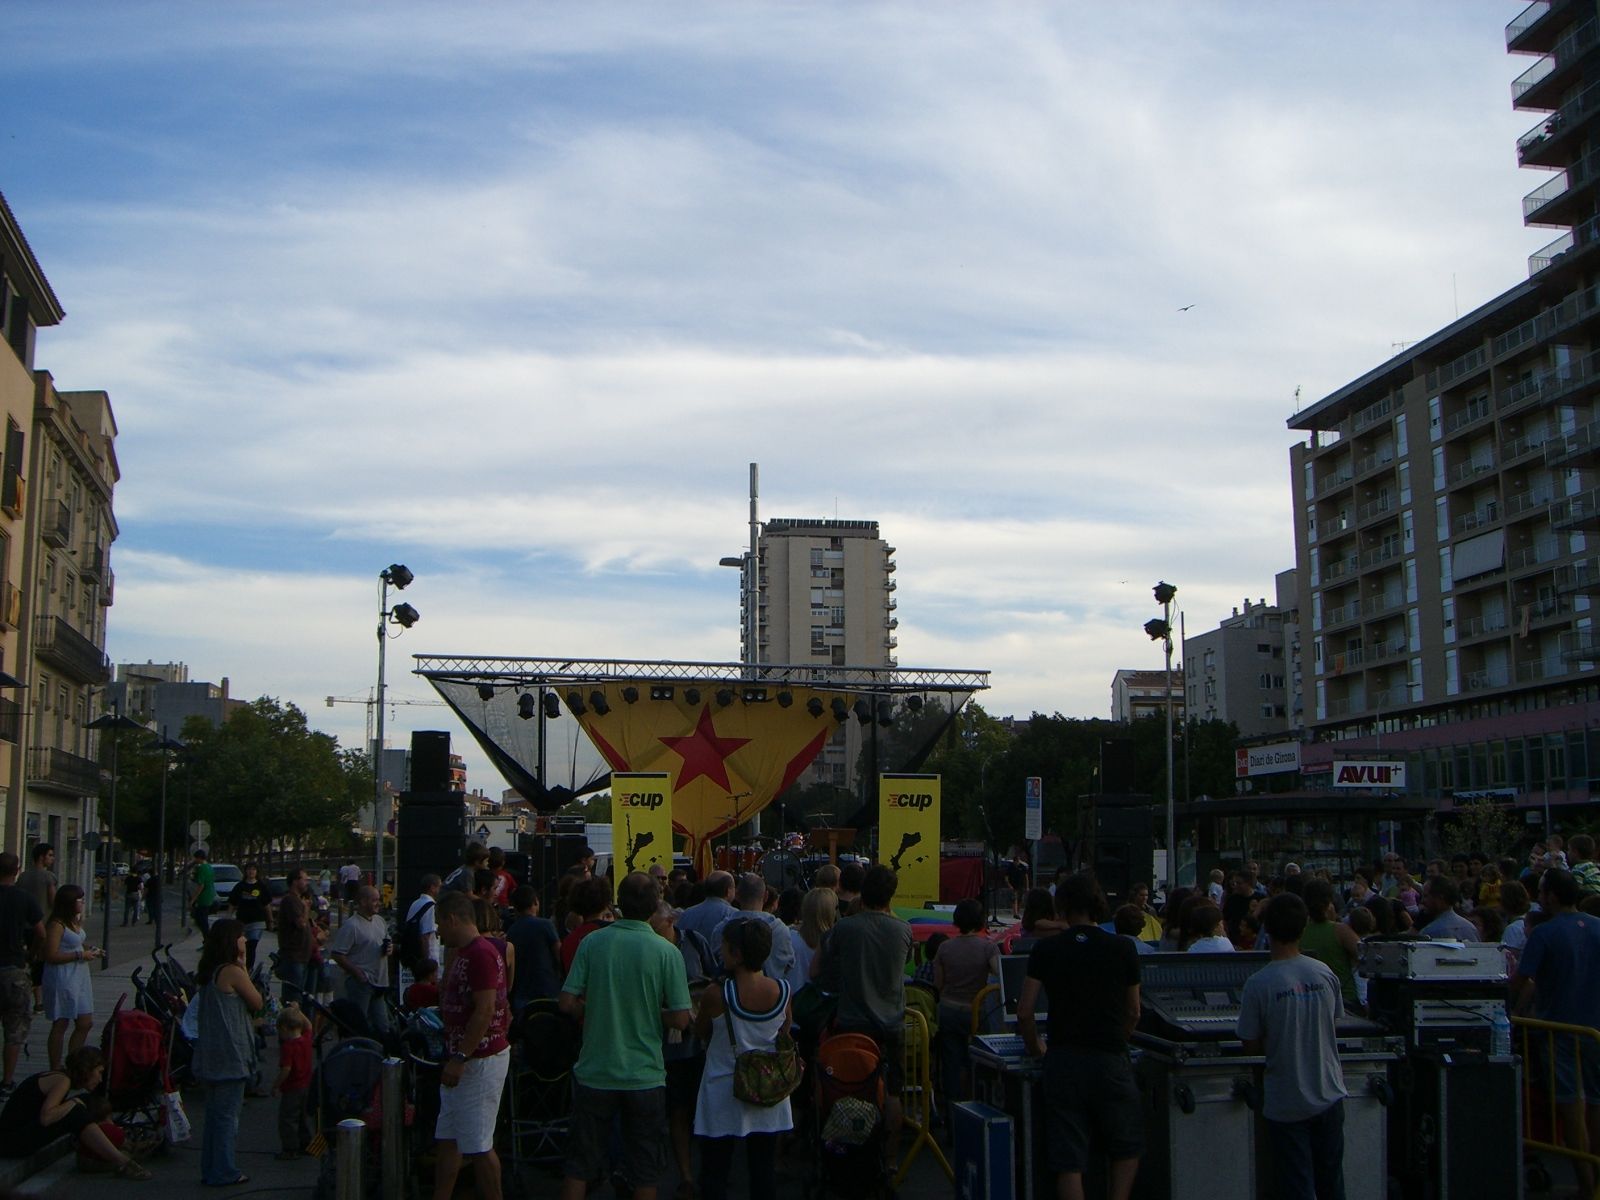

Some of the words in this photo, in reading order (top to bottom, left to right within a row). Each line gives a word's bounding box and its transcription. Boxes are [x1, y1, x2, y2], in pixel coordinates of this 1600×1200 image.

[1250, 754, 1265, 767] Diari
[1266, 753, 1274, 765] de
[1274, 752, 1296, 764] Girona
[629, 792, 664, 811] cup
[897, 793, 933, 812] cup
